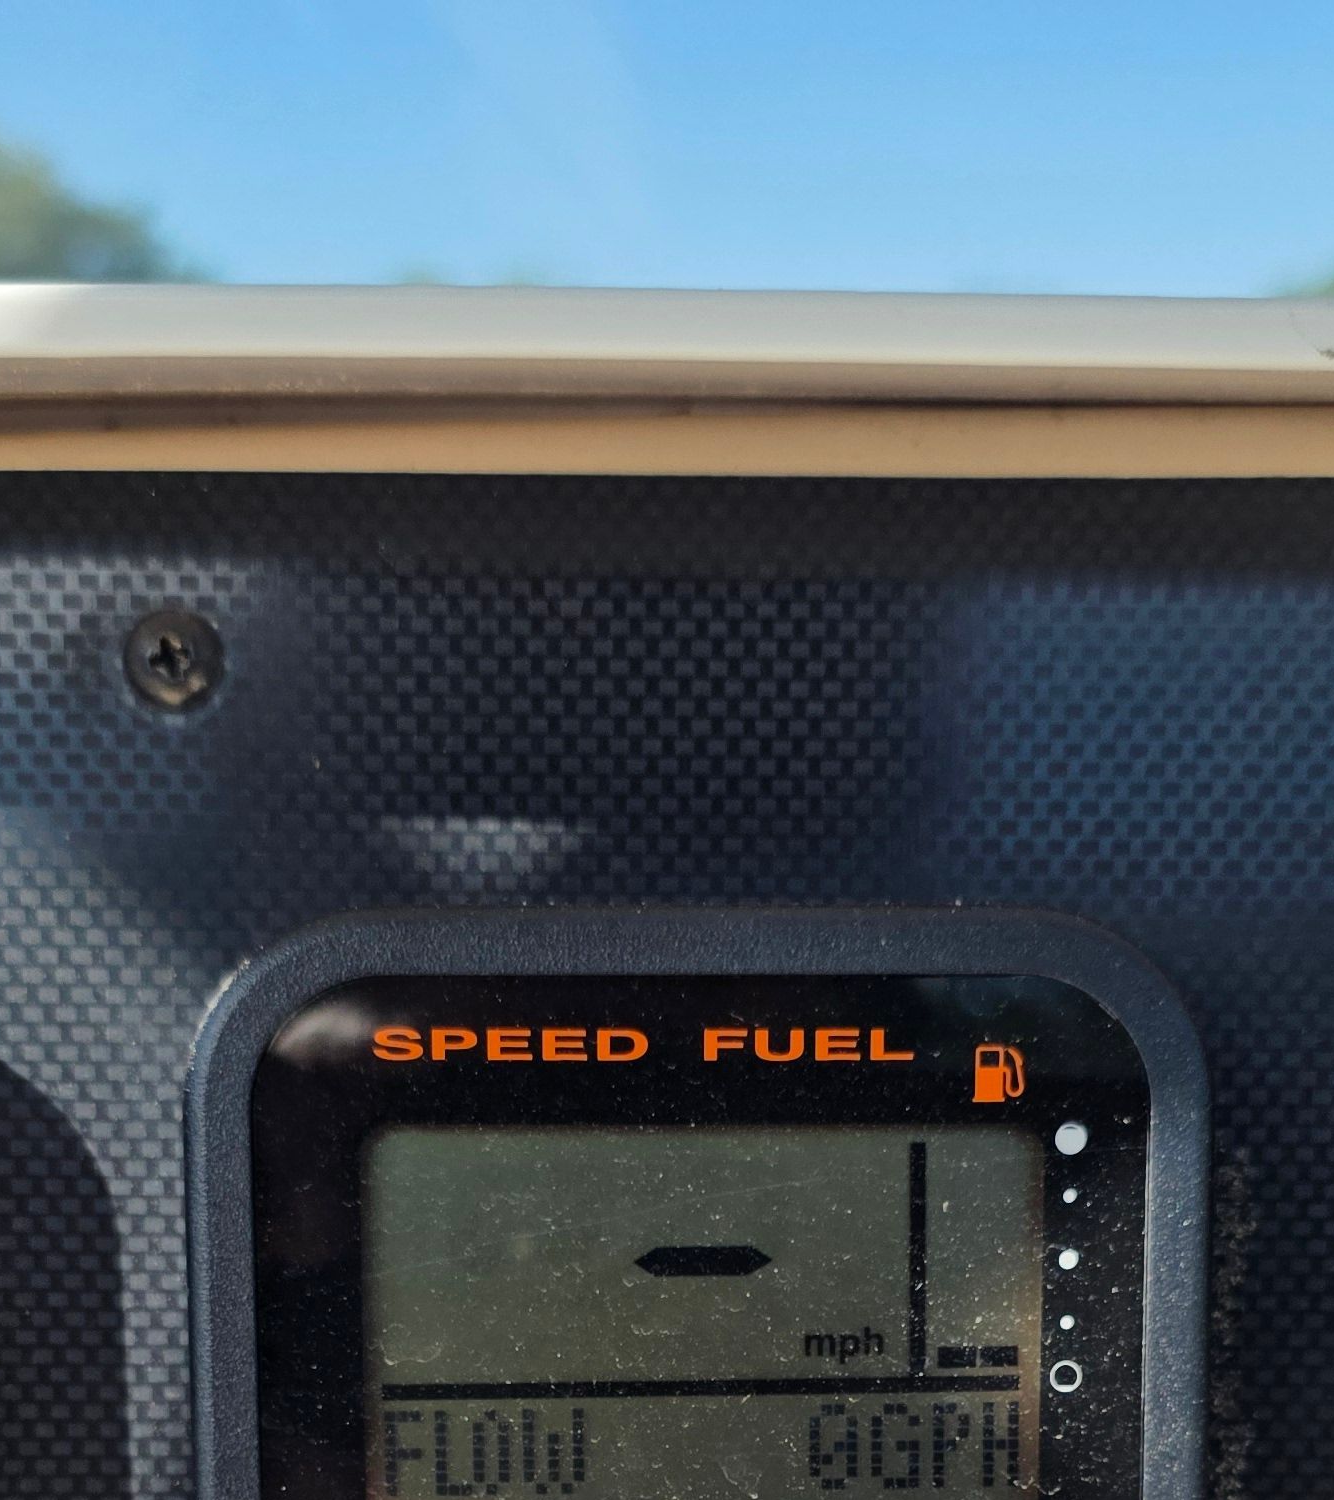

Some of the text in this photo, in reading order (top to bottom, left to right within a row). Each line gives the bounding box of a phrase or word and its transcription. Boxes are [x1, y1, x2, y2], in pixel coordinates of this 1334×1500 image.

[372, 1027, 916, 1062] SPEED FUEL
[803, 1326, 885, 1364] mph
[383, 1408, 585, 1497] FLOW
